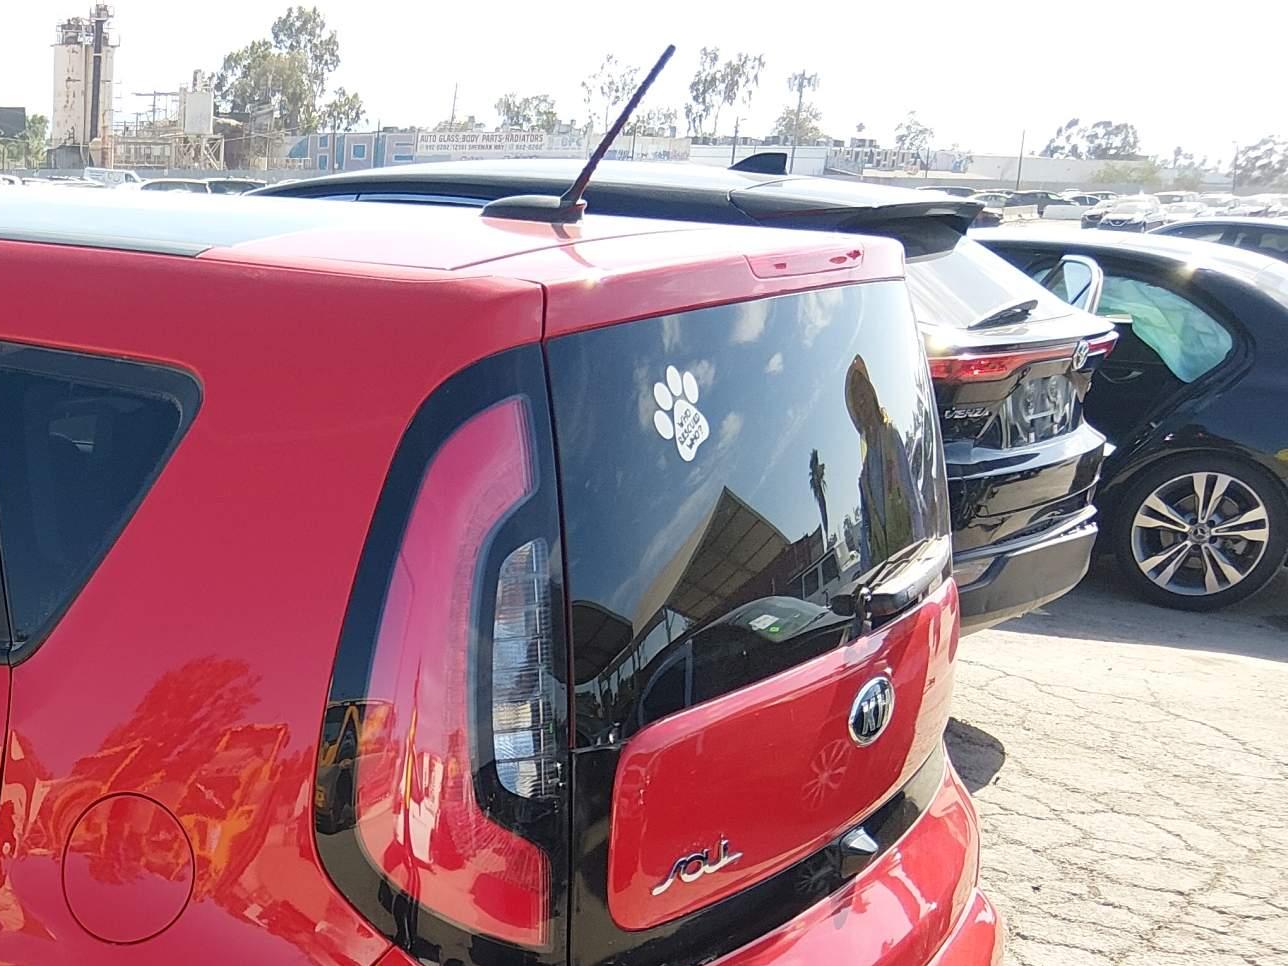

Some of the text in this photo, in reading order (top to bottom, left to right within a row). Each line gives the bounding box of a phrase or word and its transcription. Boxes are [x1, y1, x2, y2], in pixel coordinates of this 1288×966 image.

[420, 134, 437, 143] AUTO
[677, 408, 691, 428] WHO
[687, 425, 704, 450] WHO?
